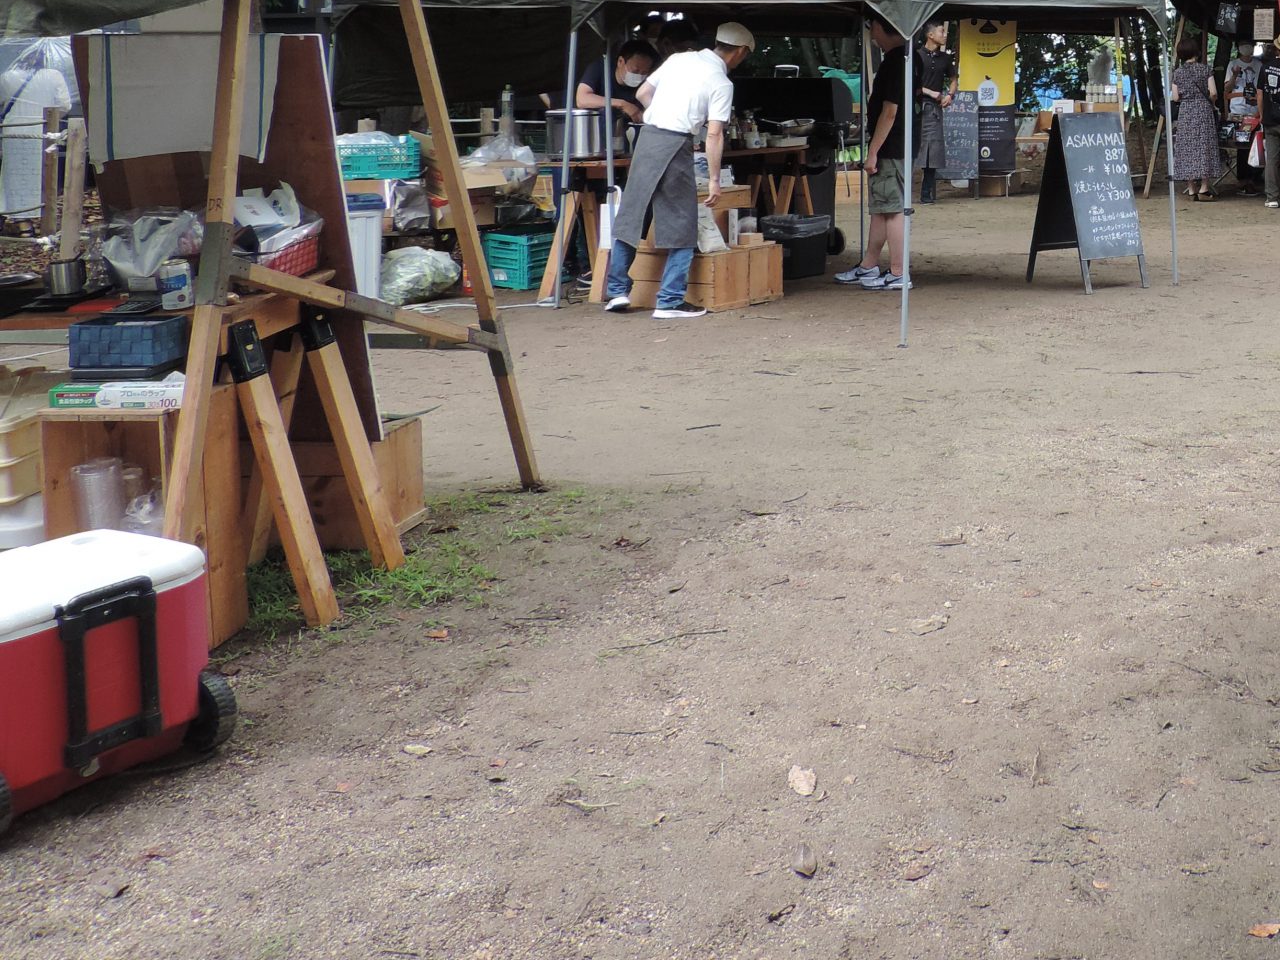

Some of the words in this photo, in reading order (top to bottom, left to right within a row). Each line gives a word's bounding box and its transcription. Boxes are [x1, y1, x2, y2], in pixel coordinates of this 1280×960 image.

[1065, 132, 1126, 148] ASAKAMAI
[1104, 147, 1125, 161] 887
[1103, 163, 1128, 176] ¥100
[1107, 189, 1131, 201] ¥300
